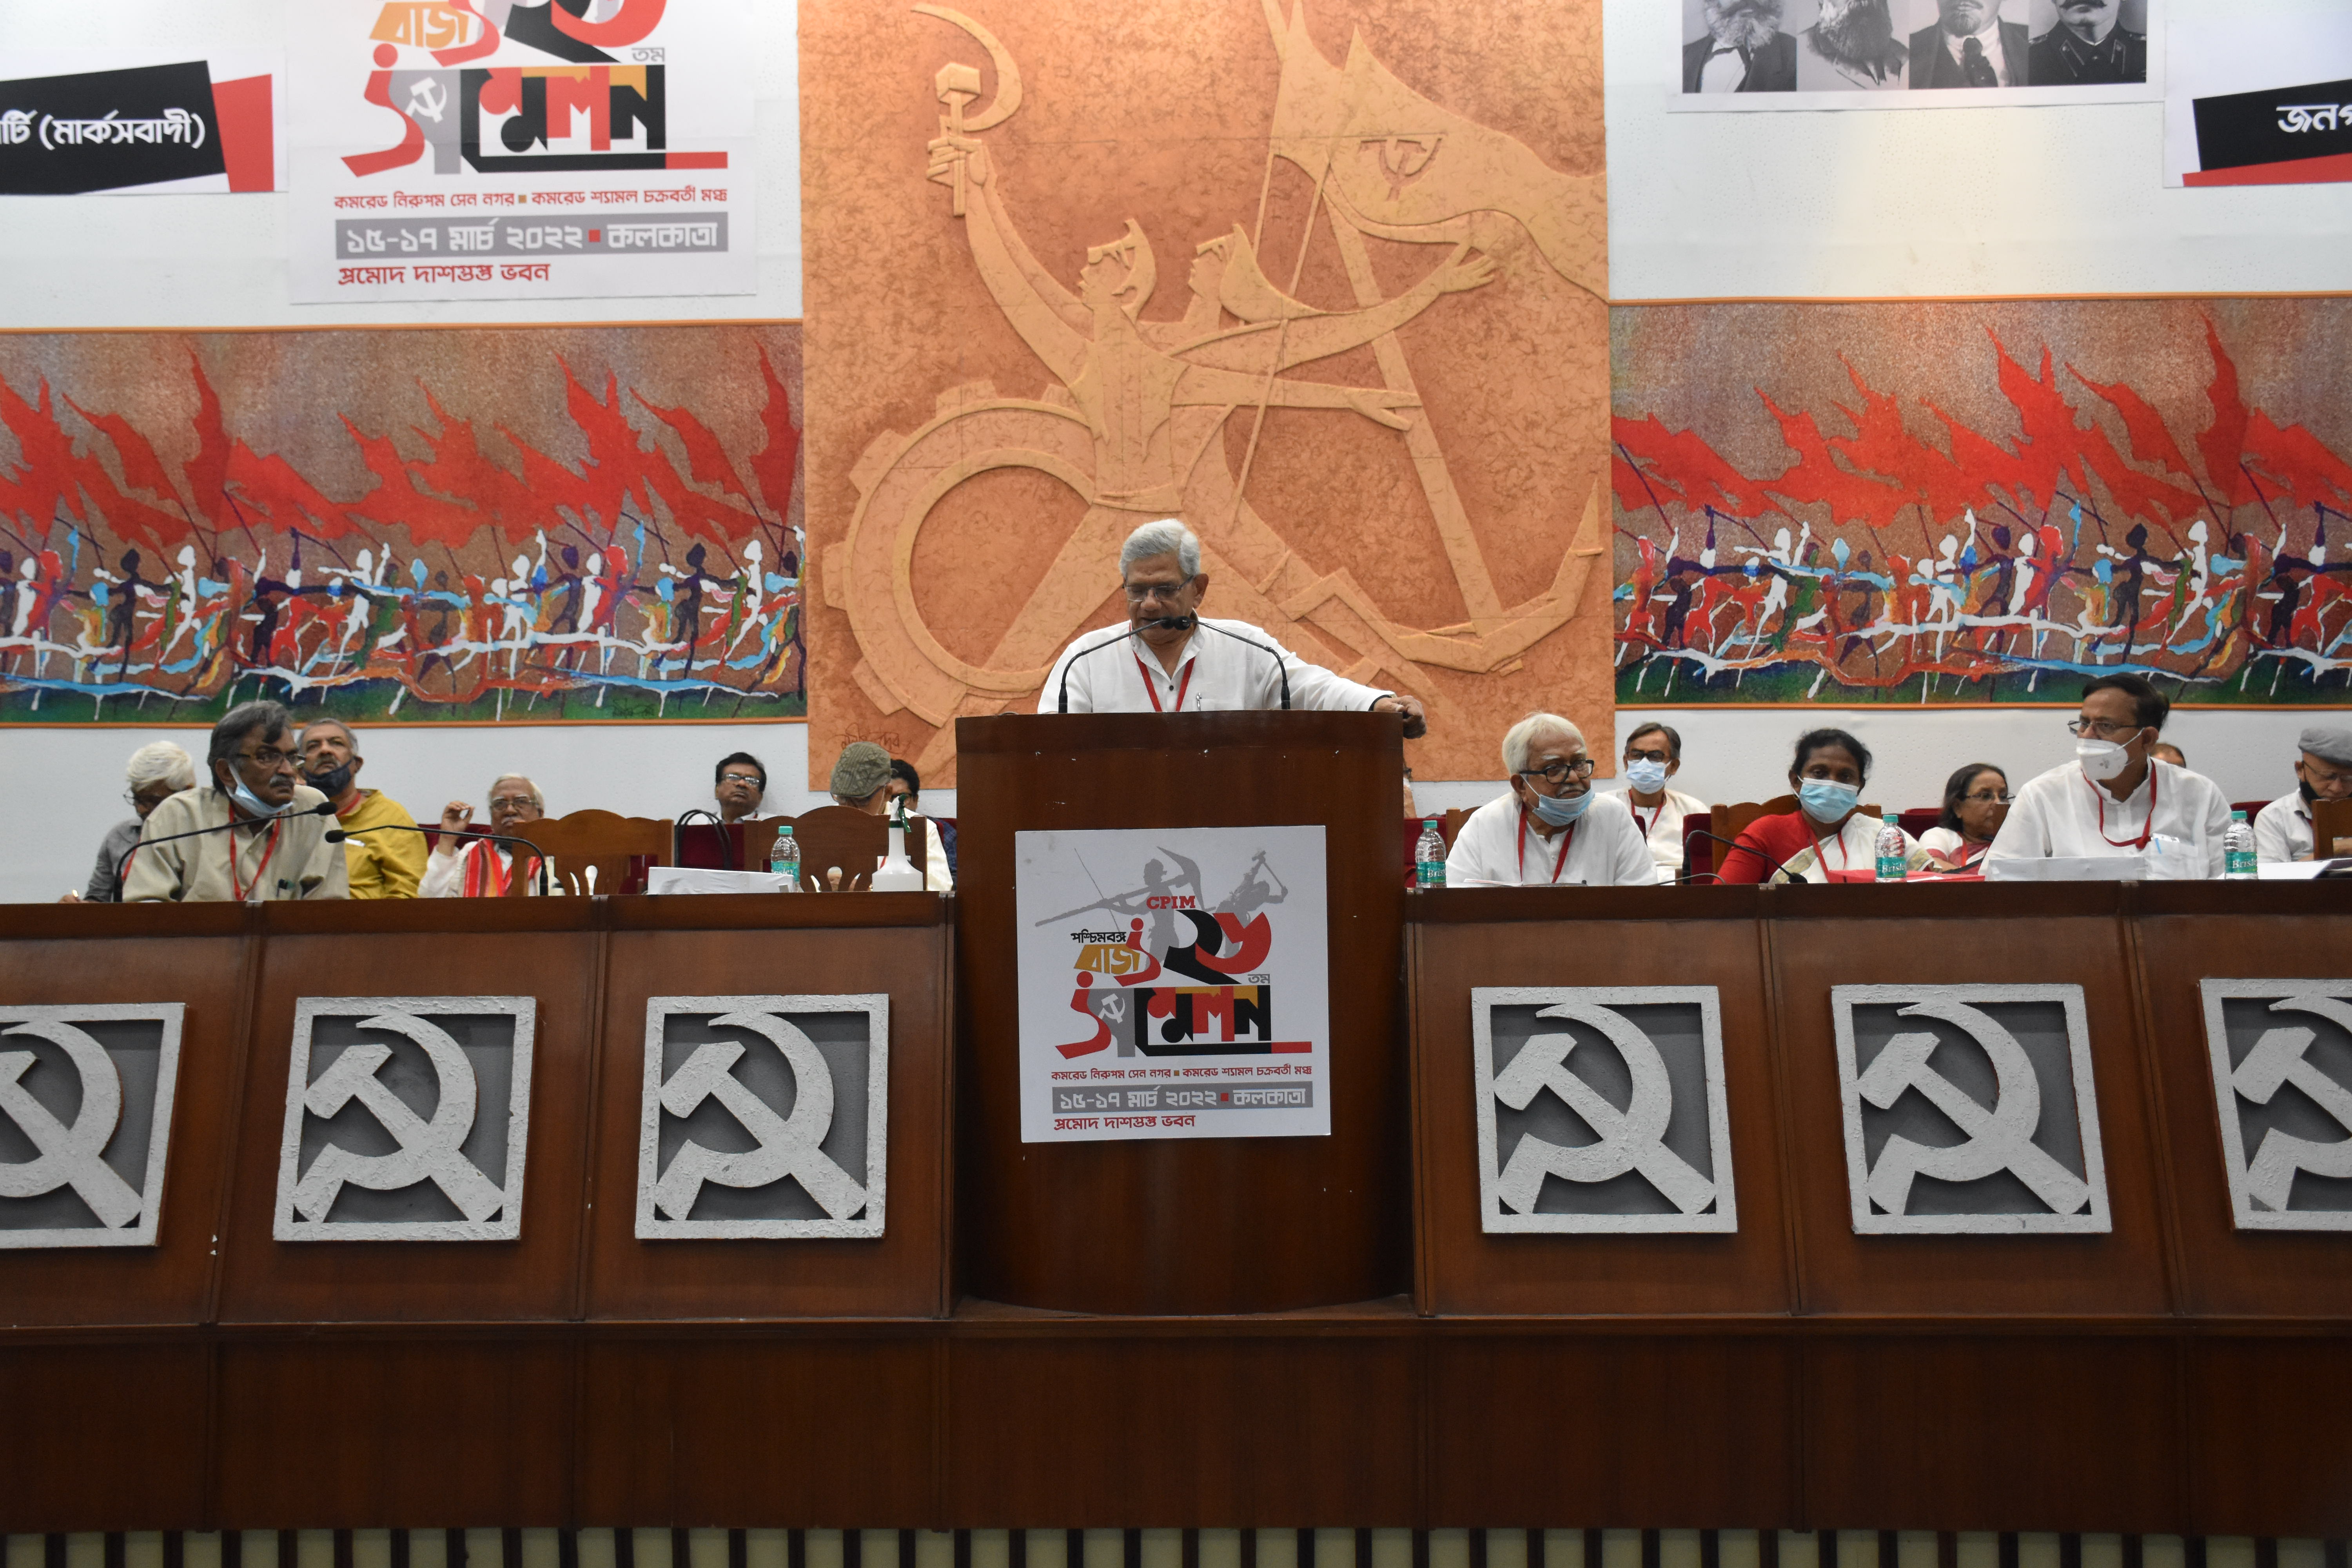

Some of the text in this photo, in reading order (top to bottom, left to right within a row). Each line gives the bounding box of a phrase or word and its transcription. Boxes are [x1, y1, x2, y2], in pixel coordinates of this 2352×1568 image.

[632, 48, 664, 62] তম
[39, 107, 205, 151] (মার্কসবাদী)
[335, 185, 728, 209] কমরেড নিরুপম সেন নগর কমরেড শ্যামল চক্রবর্তী মঞ্চ
[347, 218, 718, 253] ১৫-১৭ মার্চ ২০২২ কলকাতা
[338, 263, 550, 286] প্রমোদ দাশগুপ্ত ভবন
[1882, 863, 1906, 873] Brisle
[1146, 895, 1196, 910] CPIM
[1070, 929, 1127, 943] পশ্চিমবঙ্গ
[1163, 909, 1272, 985] ২৬
[1247, 973, 1270, 984] তম
[1051, 1063, 1312, 1080] কমরেড নিরুপম সেন নগর কমরেড শ্যামল চক্রবর্তী মঞ্চ
[1060, 1085, 1306, 1109] ১৫-১৭ মার্চ ২০২২ কলকাতা
[1054, 1115, 1196, 1131] প্রমোদ দাশগুপ্ত ভবন
